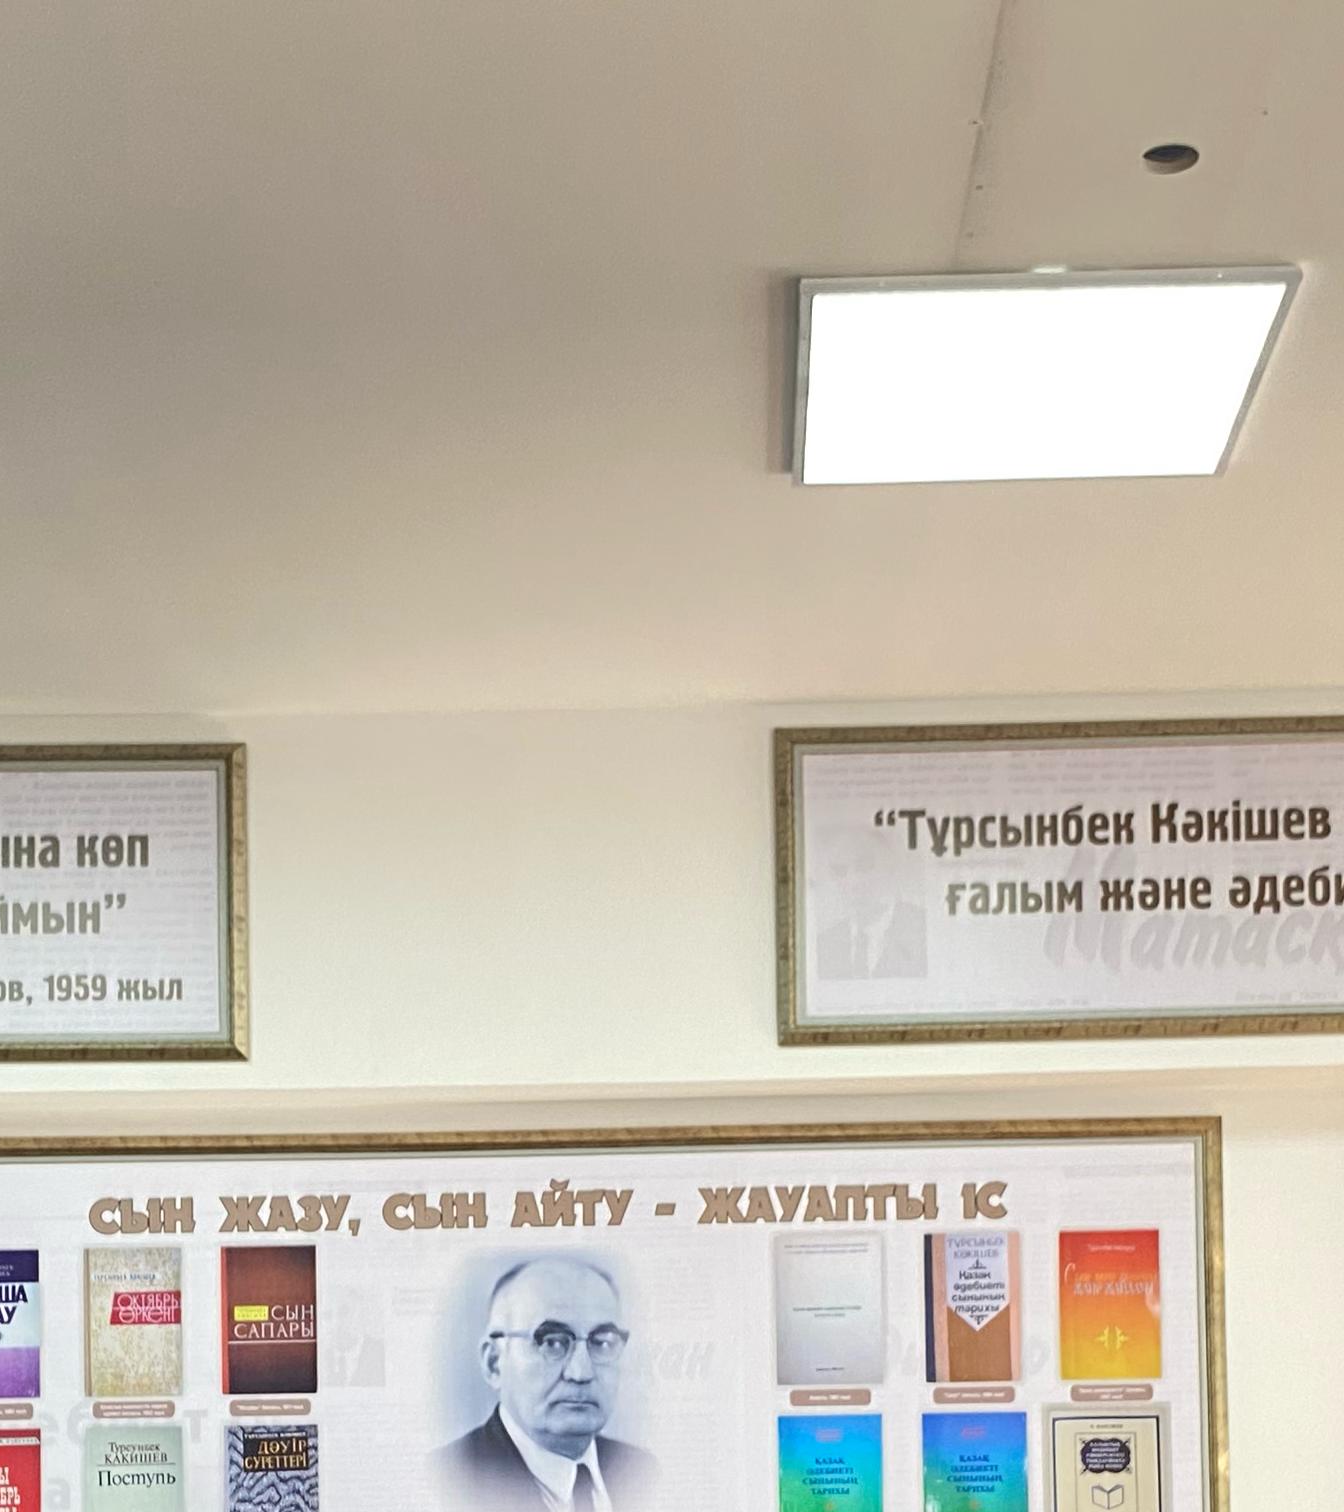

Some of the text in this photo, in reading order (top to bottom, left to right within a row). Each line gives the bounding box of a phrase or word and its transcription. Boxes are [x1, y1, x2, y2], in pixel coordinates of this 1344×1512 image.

[874, 809, 1134, 857] “Тұрсынбек
[1150, 802, 1331, 846] Кәкішев
[77, 833, 149, 868] көп
[946, 878, 1084, 916] ғалым
[1100, 877, 1212, 911] және
[43, 975, 107, 1001] 1959
[118, 976, 182, 1000] жыл
[89, 1197, 194, 1234] СЫН
[219, 1194, 361, 1236] ЖАЗУ,
[382, 1192, 488, 1231] СЫН
[511, 1178, 633, 1227] АЙТУ
[697, 1181, 939, 1224] ЖАУАПТЫ
[271, 1305, 314, 1321] СЫН
[234, 1322, 314, 1339] САПАРЫ
[105, 1452, 168, 1465] КАКИШЕВ
[97, 1471, 176, 1488] Поступь
